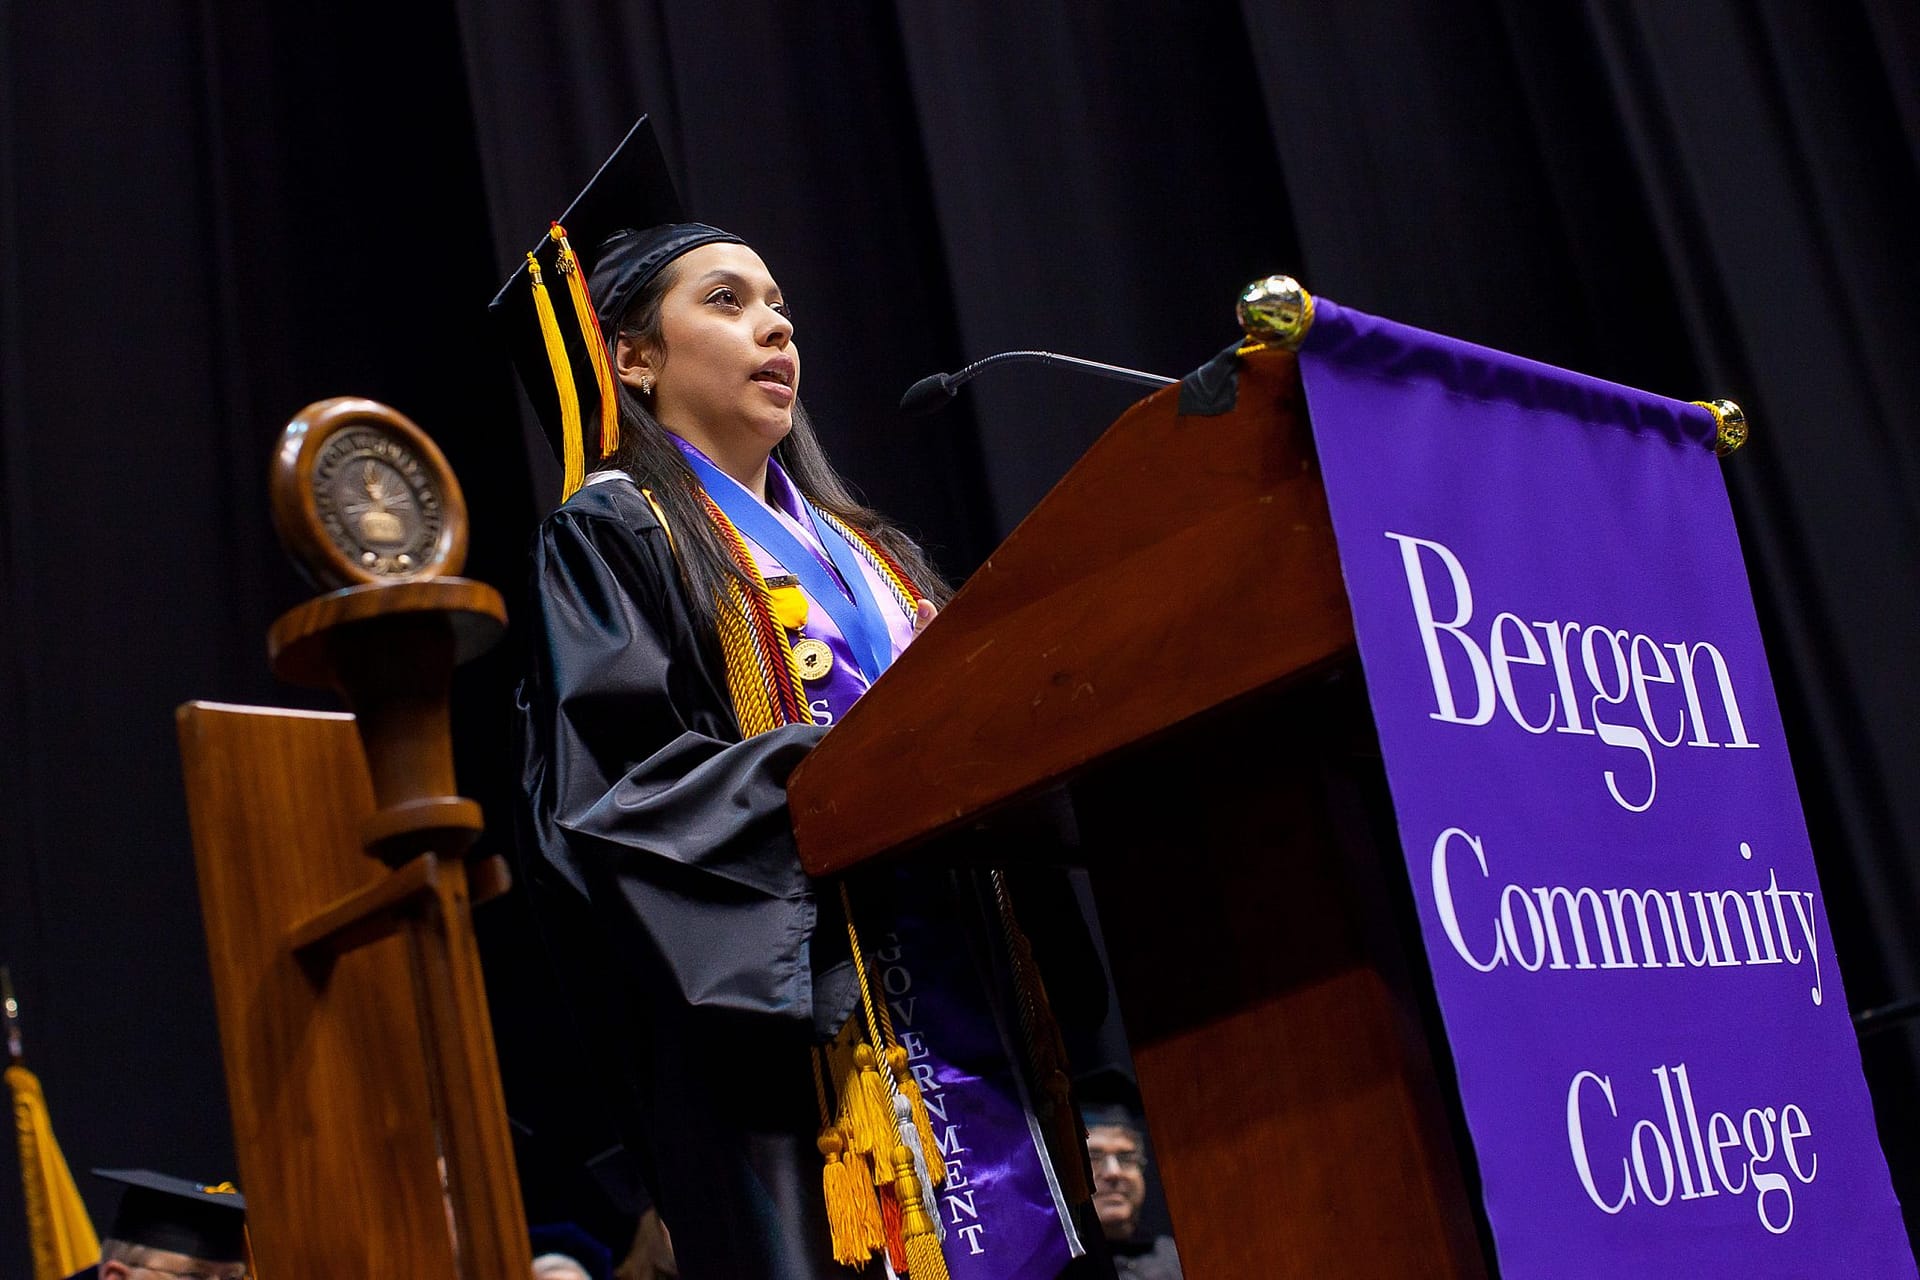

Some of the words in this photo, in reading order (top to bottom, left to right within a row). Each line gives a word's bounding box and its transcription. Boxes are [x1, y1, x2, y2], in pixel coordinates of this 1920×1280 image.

[1384, 531, 1760, 813] Bergen
[1431, 827, 1822, 1006] Community
[877, 932, 985, 1256] GOVERNMENT
[1566, 1063, 1817, 1234] College
